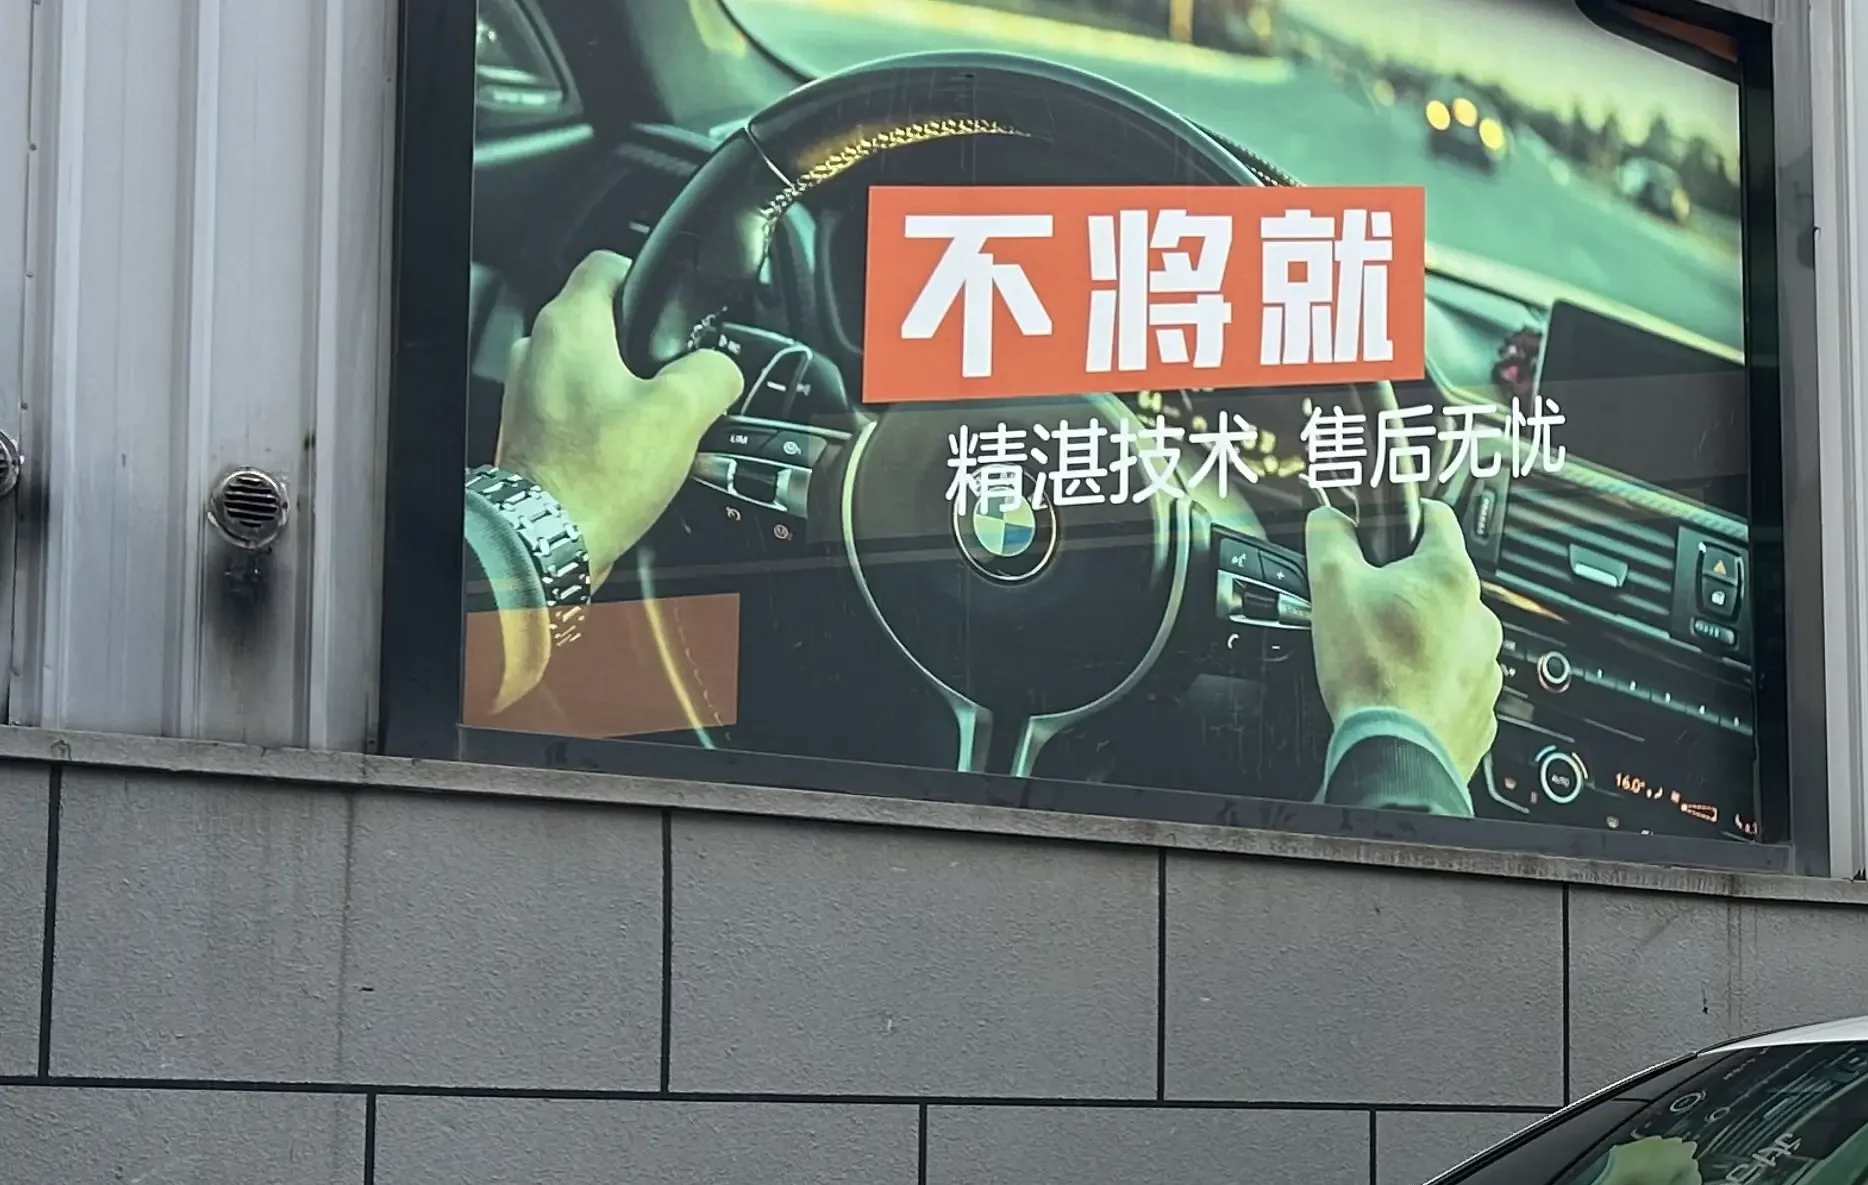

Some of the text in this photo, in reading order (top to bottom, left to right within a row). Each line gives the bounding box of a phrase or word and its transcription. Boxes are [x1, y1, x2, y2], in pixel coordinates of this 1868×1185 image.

[901, 209, 1393, 377] 不将就
[945, 395, 1566, 517] 精湛技术 售后无忧
